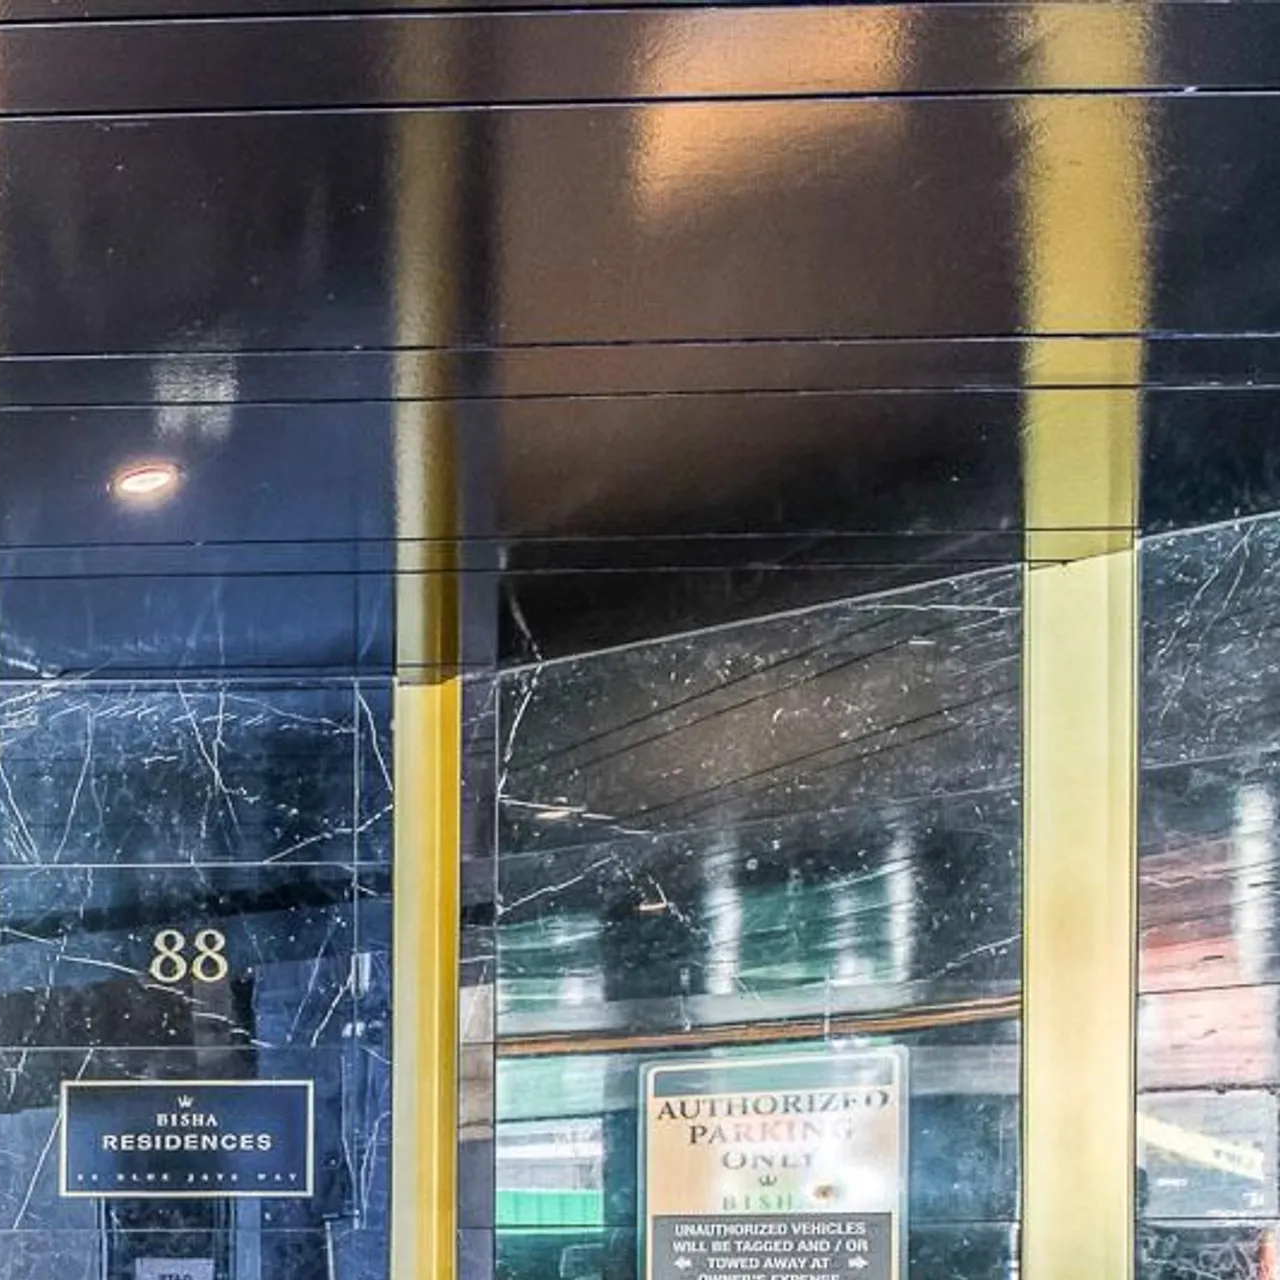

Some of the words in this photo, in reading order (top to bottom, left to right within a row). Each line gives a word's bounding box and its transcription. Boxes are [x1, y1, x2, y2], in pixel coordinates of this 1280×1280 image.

[150, 929, 228, 983] 88
[657, 1090, 890, 1121] AUTHORIZED
[156, 1113, 219, 1127] BISHA
[689, 1117, 854, 1144] PARKING
[102, 1133, 272, 1152] RESIDENCES
[674, 1222, 787, 1237] UNAUTHORIZED
[792, 1221, 867, 1236] VEHICLES
[672, 1241, 708, 1253] WILL
[712, 1241, 731, 1252] BE
[736, 1240, 794, 1252] TAGGED
[797, 1240, 831, 1252] AND
[845, 1239, 869, 1252] OR
[707, 1257, 760, 1270] TOWED
[763, 1257, 806, 1269] AWAY
[809, 1257, 830, 1269] AT
